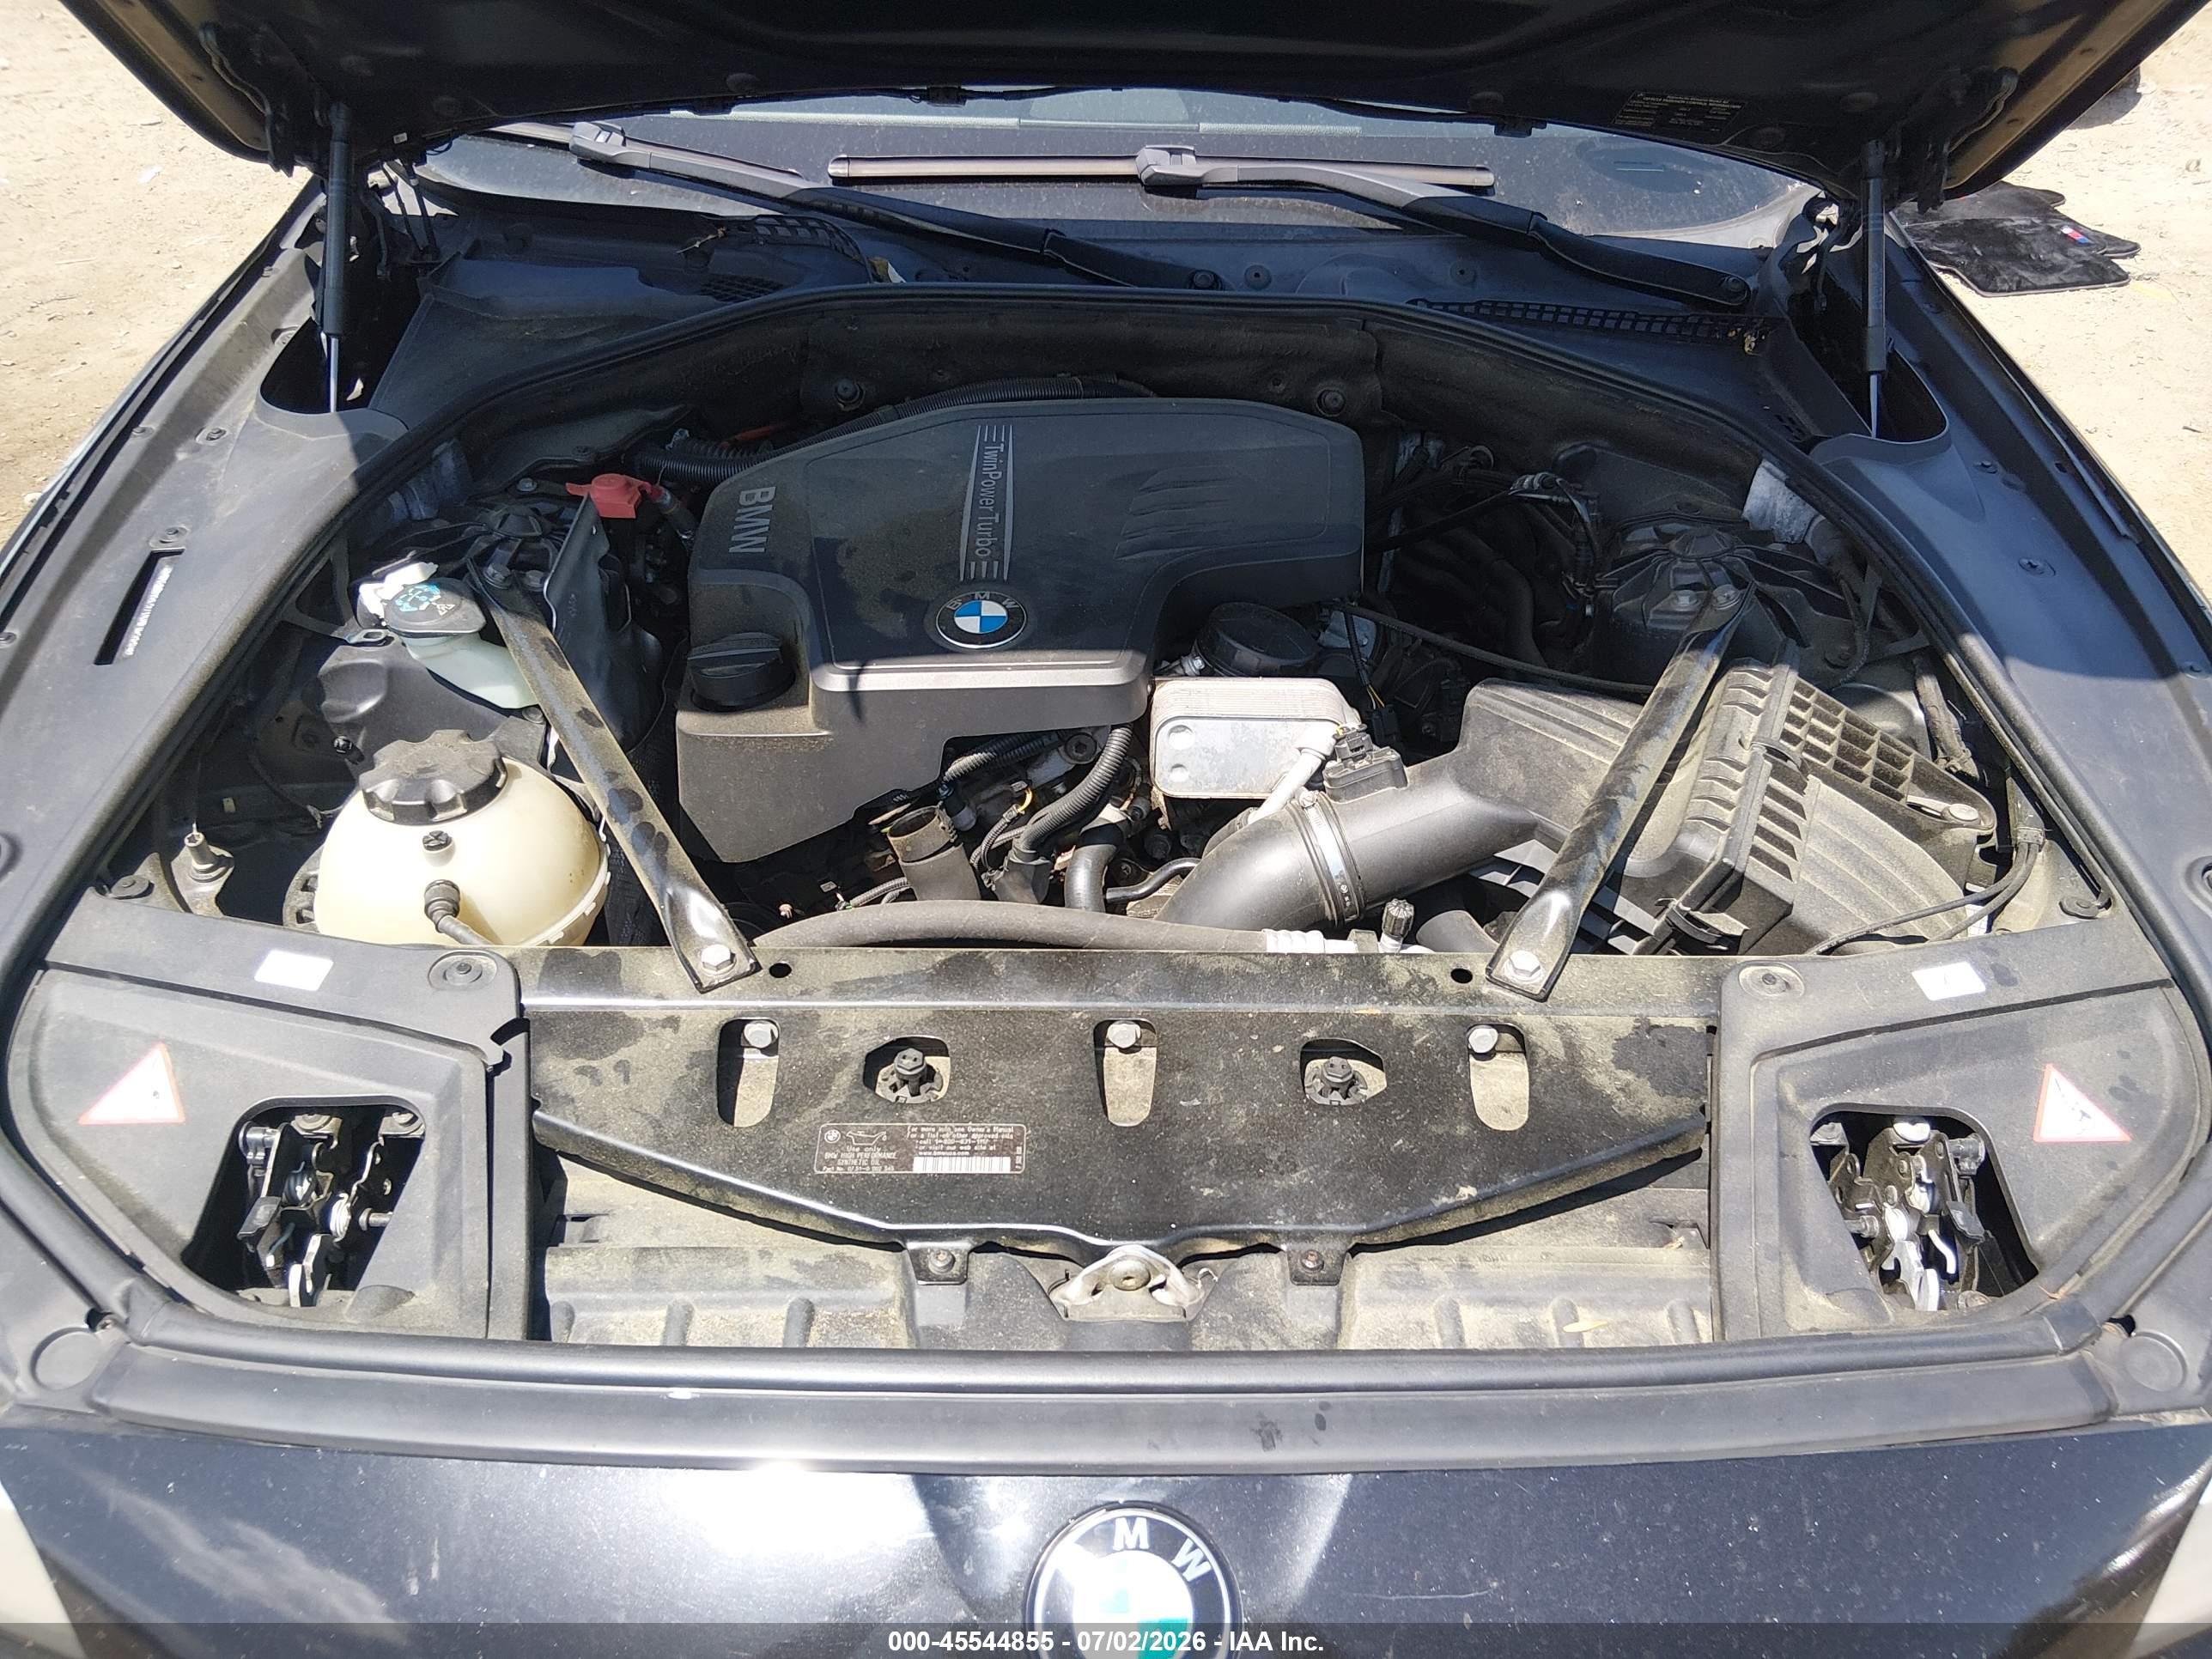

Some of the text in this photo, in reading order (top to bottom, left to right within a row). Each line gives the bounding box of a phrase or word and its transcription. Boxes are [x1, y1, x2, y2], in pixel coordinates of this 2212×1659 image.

[729, 487, 776, 553] BMW
[945, 591, 1019, 611] BMW
[864, 1144, 882, 1152] only
[1078, 1516, 1212, 1583] MW
